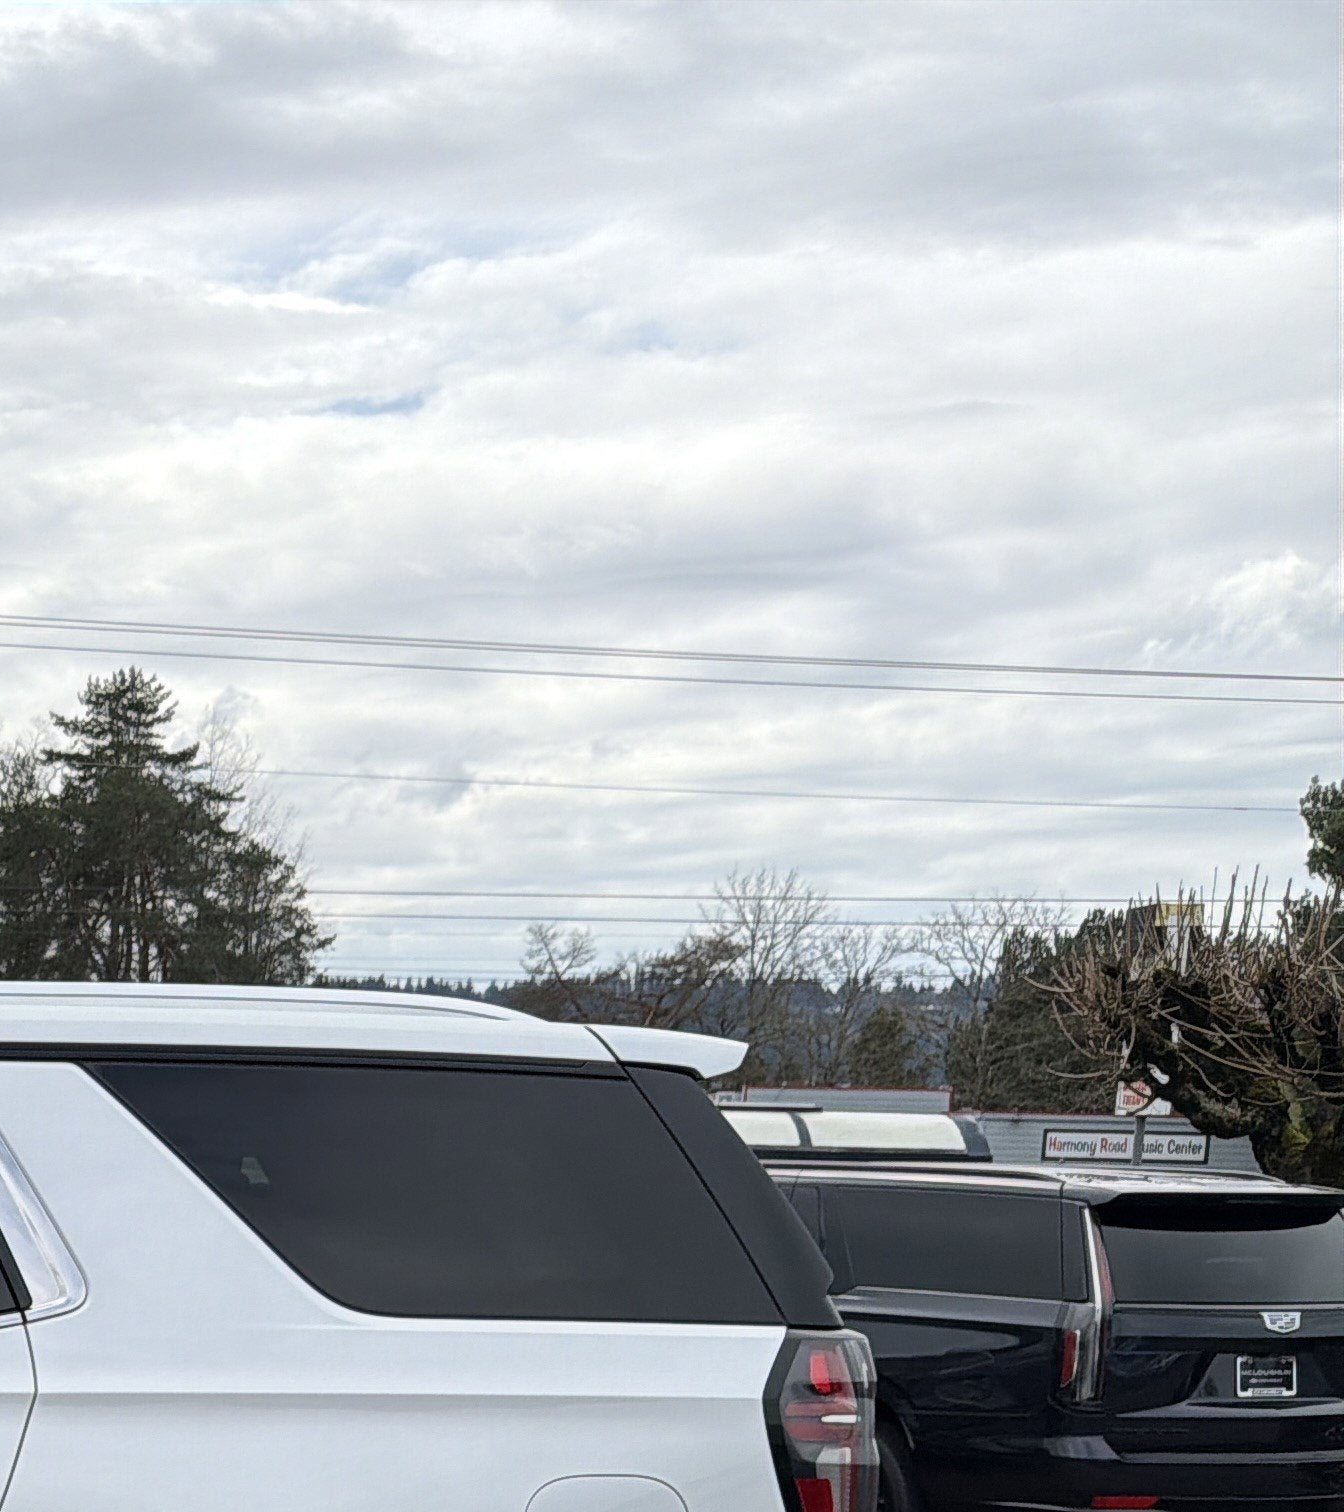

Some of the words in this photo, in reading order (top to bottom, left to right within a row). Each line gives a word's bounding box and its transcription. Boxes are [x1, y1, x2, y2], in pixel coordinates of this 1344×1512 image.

[1048, 1136, 1097, 1156] Harmony
[1100, 1137, 1128, 1152] Road
[1142, 1139, 1163, 1154] usic
[1167, 1138, 1203, 1155] Center
